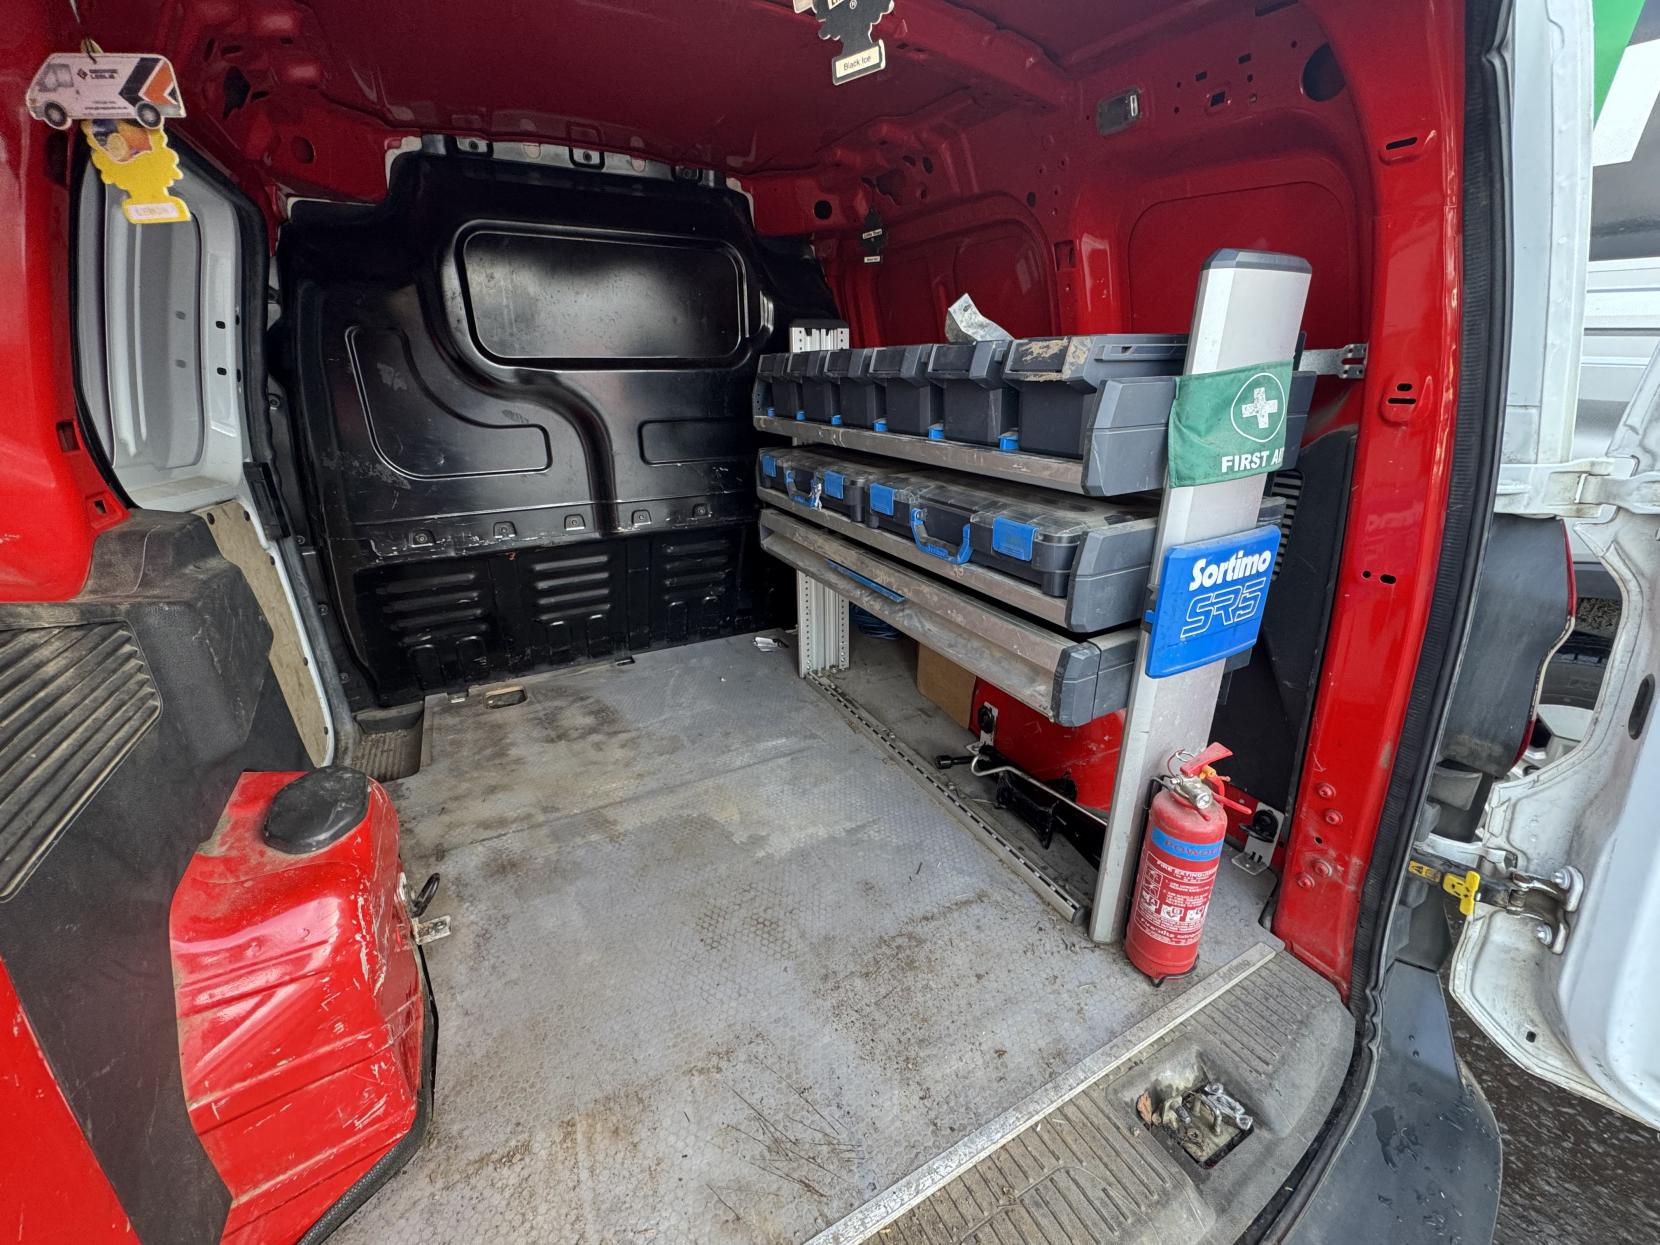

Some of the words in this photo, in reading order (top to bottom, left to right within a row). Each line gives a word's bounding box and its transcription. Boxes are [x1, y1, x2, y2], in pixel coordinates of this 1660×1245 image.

[843, 58, 861, 71] Black
[862, 56, 872, 64] Ice
[1221, 450, 1270, 473] FIRST
[1189, 550, 1272, 591] Sortimo
